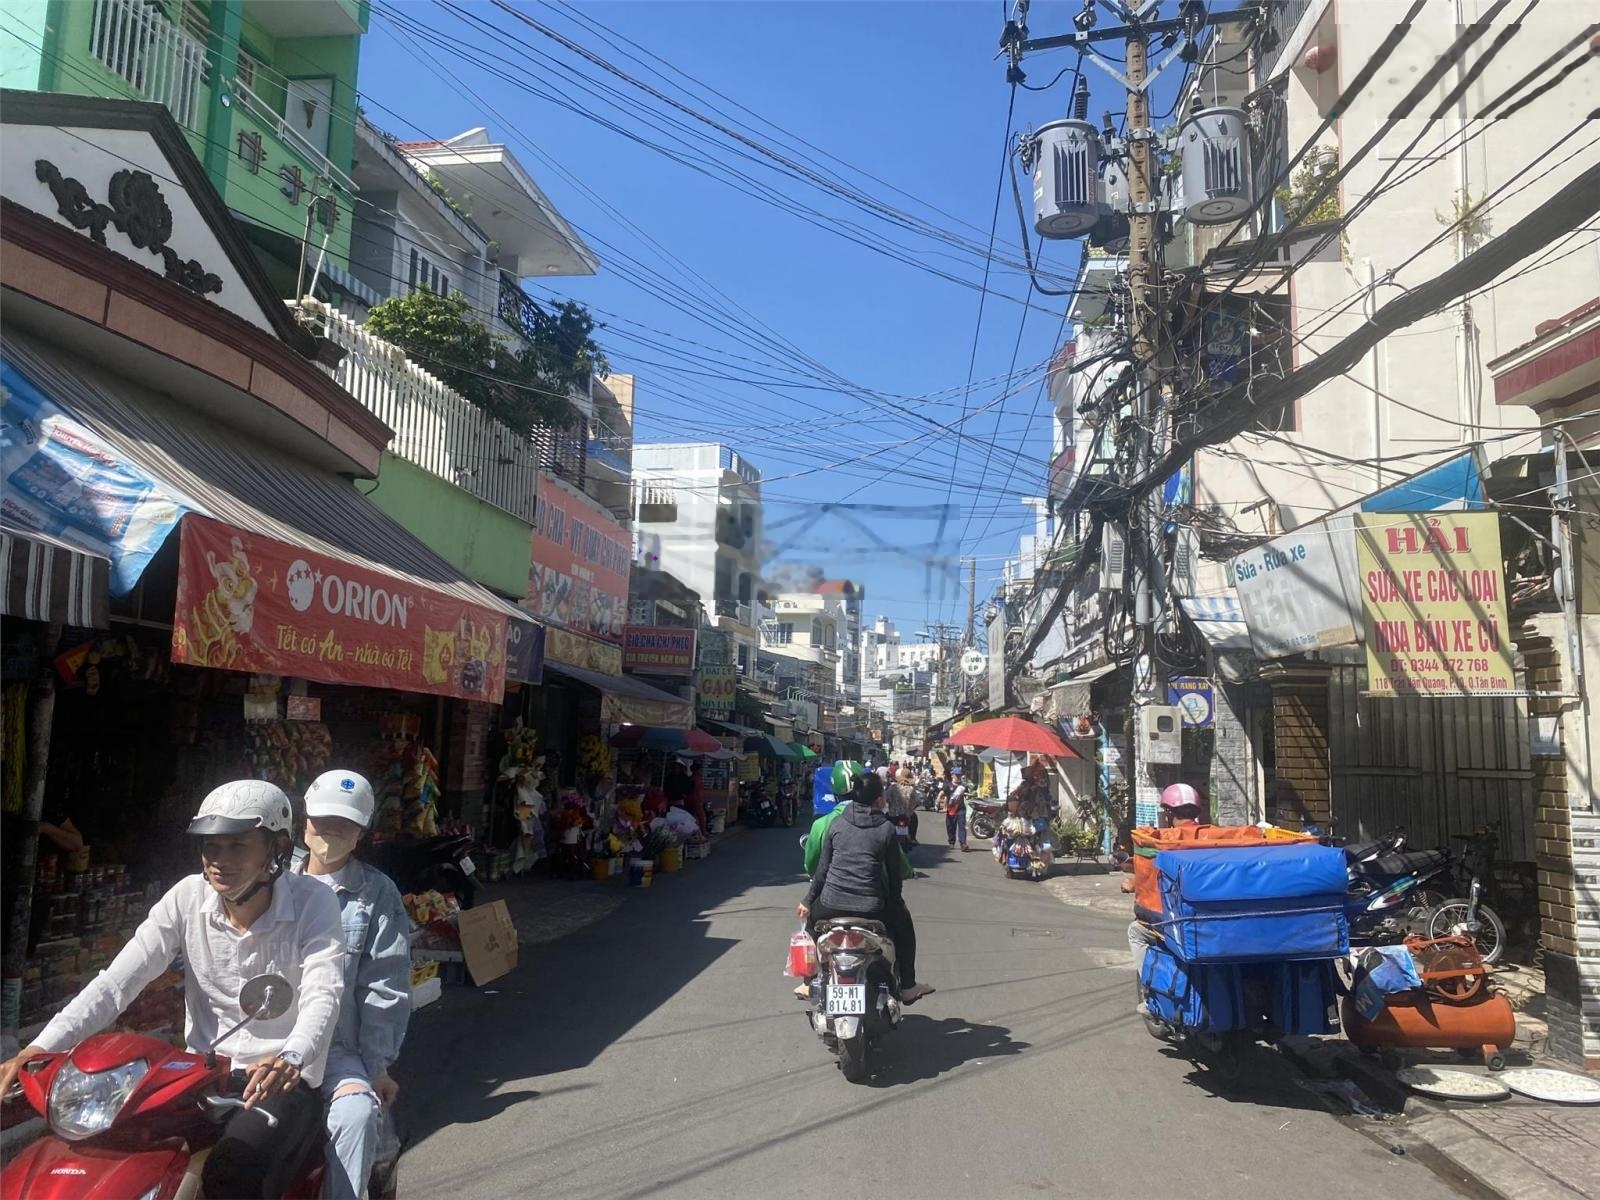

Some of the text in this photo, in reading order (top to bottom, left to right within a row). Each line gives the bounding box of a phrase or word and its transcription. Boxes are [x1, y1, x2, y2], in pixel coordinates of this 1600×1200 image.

[1385, 518, 1471, 554] HẢI
[1236, 559, 1257, 582] Sửa
[1263, 547, 1288, 572] Rửa
[1289, 544, 1306, 562] xe
[322, 574, 408, 630] ORION
[1368, 563, 1498, 609] SỬA XE CÁC LOẠI
[277, 624, 298, 651] Tết
[301, 632, 316, 655] có
[319, 629, 344, 661] An
[355, 643, 379, 666] nhà
[397, 648, 413, 672] Tết
[1375, 613, 1499, 653] MUA BÁN XE CŨ
[1410, 658, 1440, 672] 0344
[1468, 659, 1489, 672] 768
[1490, 675, 1507, 689] Bình
[703, 679, 734, 698] GẠO
[829, 1000, 862, 1012] 814.81
